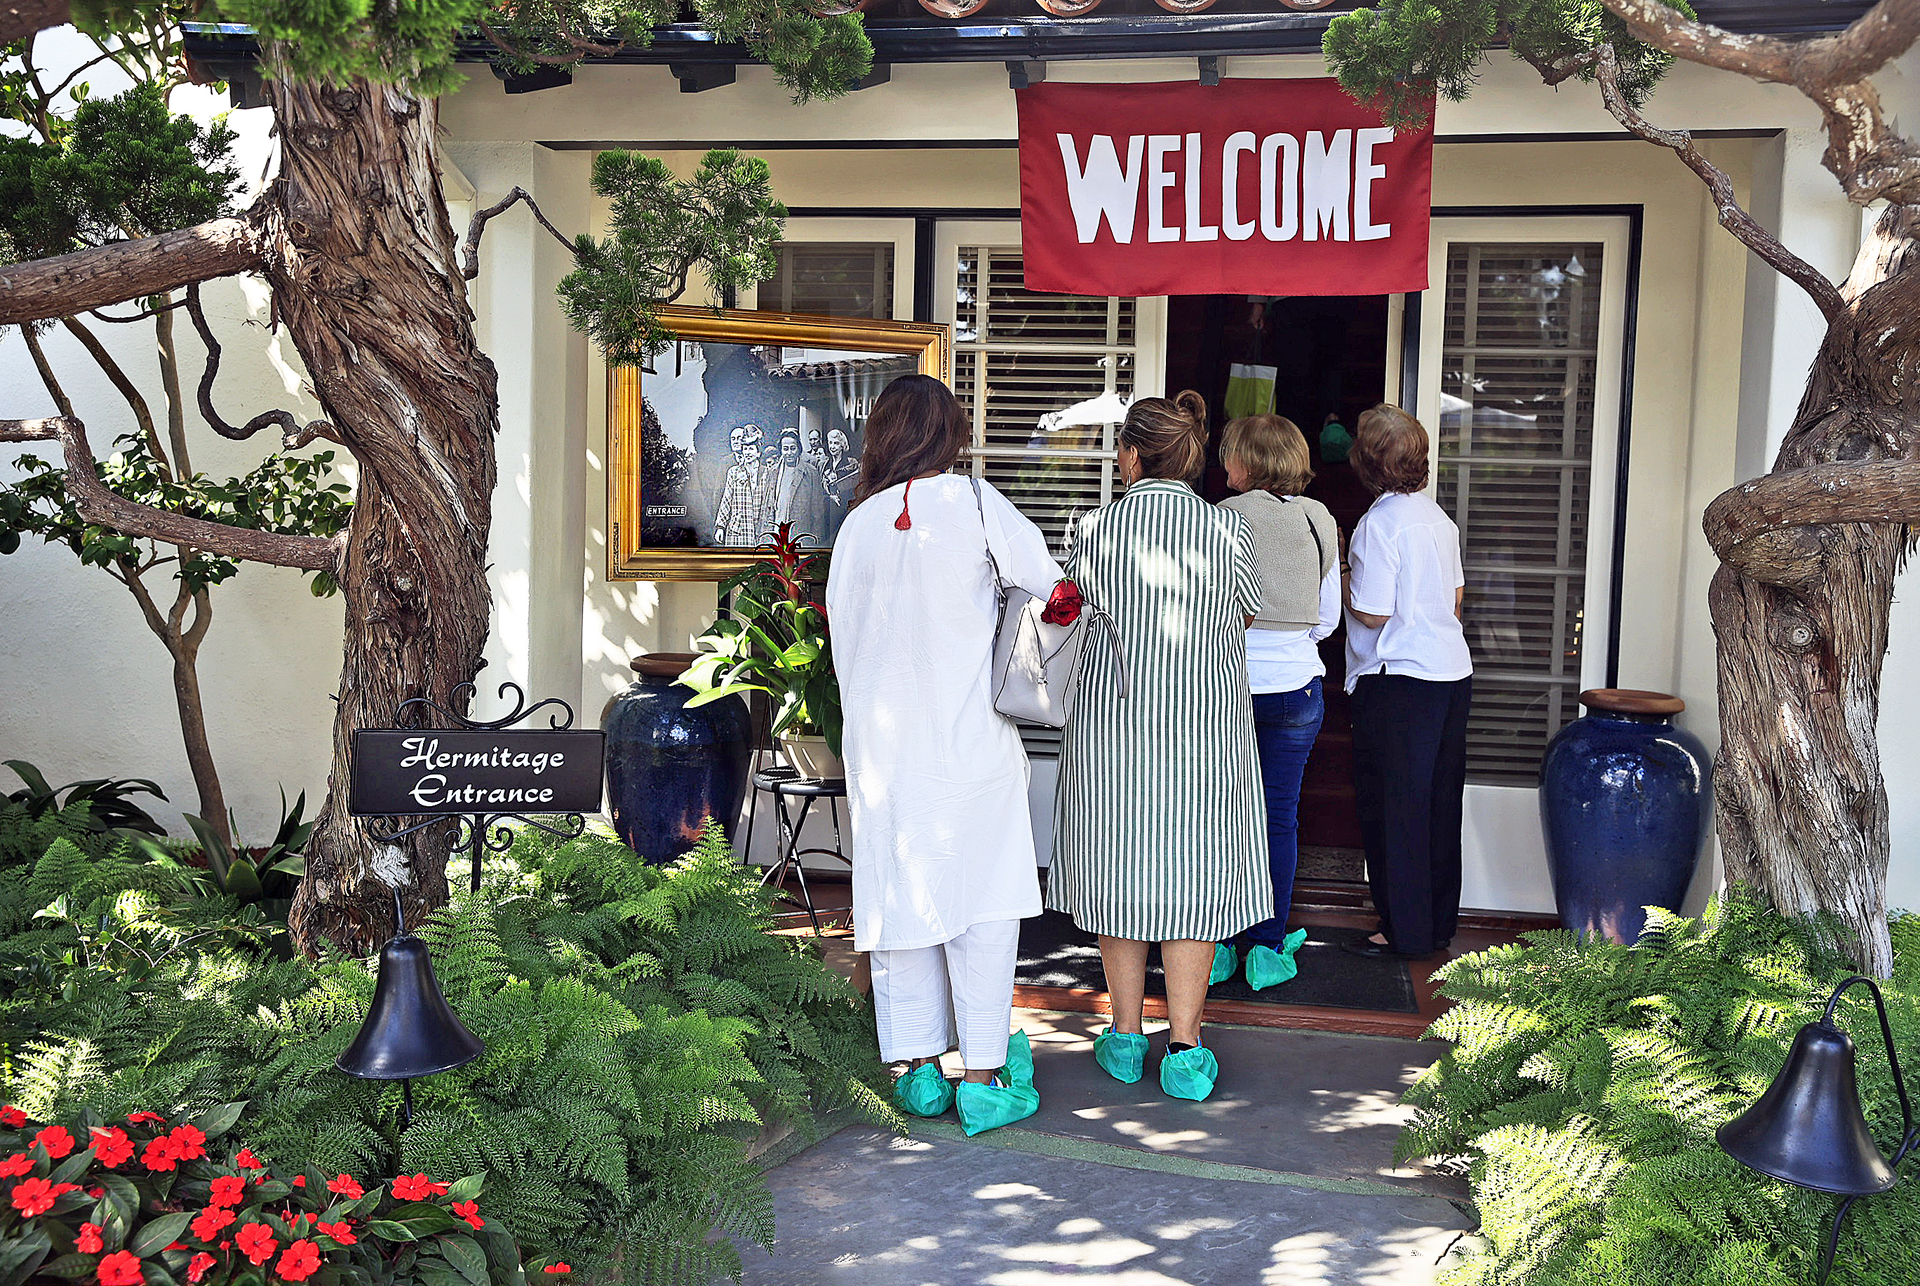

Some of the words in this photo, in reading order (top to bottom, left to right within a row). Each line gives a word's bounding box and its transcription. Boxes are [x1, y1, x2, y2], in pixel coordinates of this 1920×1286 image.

[1055, 126, 1396, 246] WELCOME
[647, 507, 685, 515] ENTRANCE
[399, 736, 565, 775] Hermitage
[408, 773, 554, 807] Entrance
